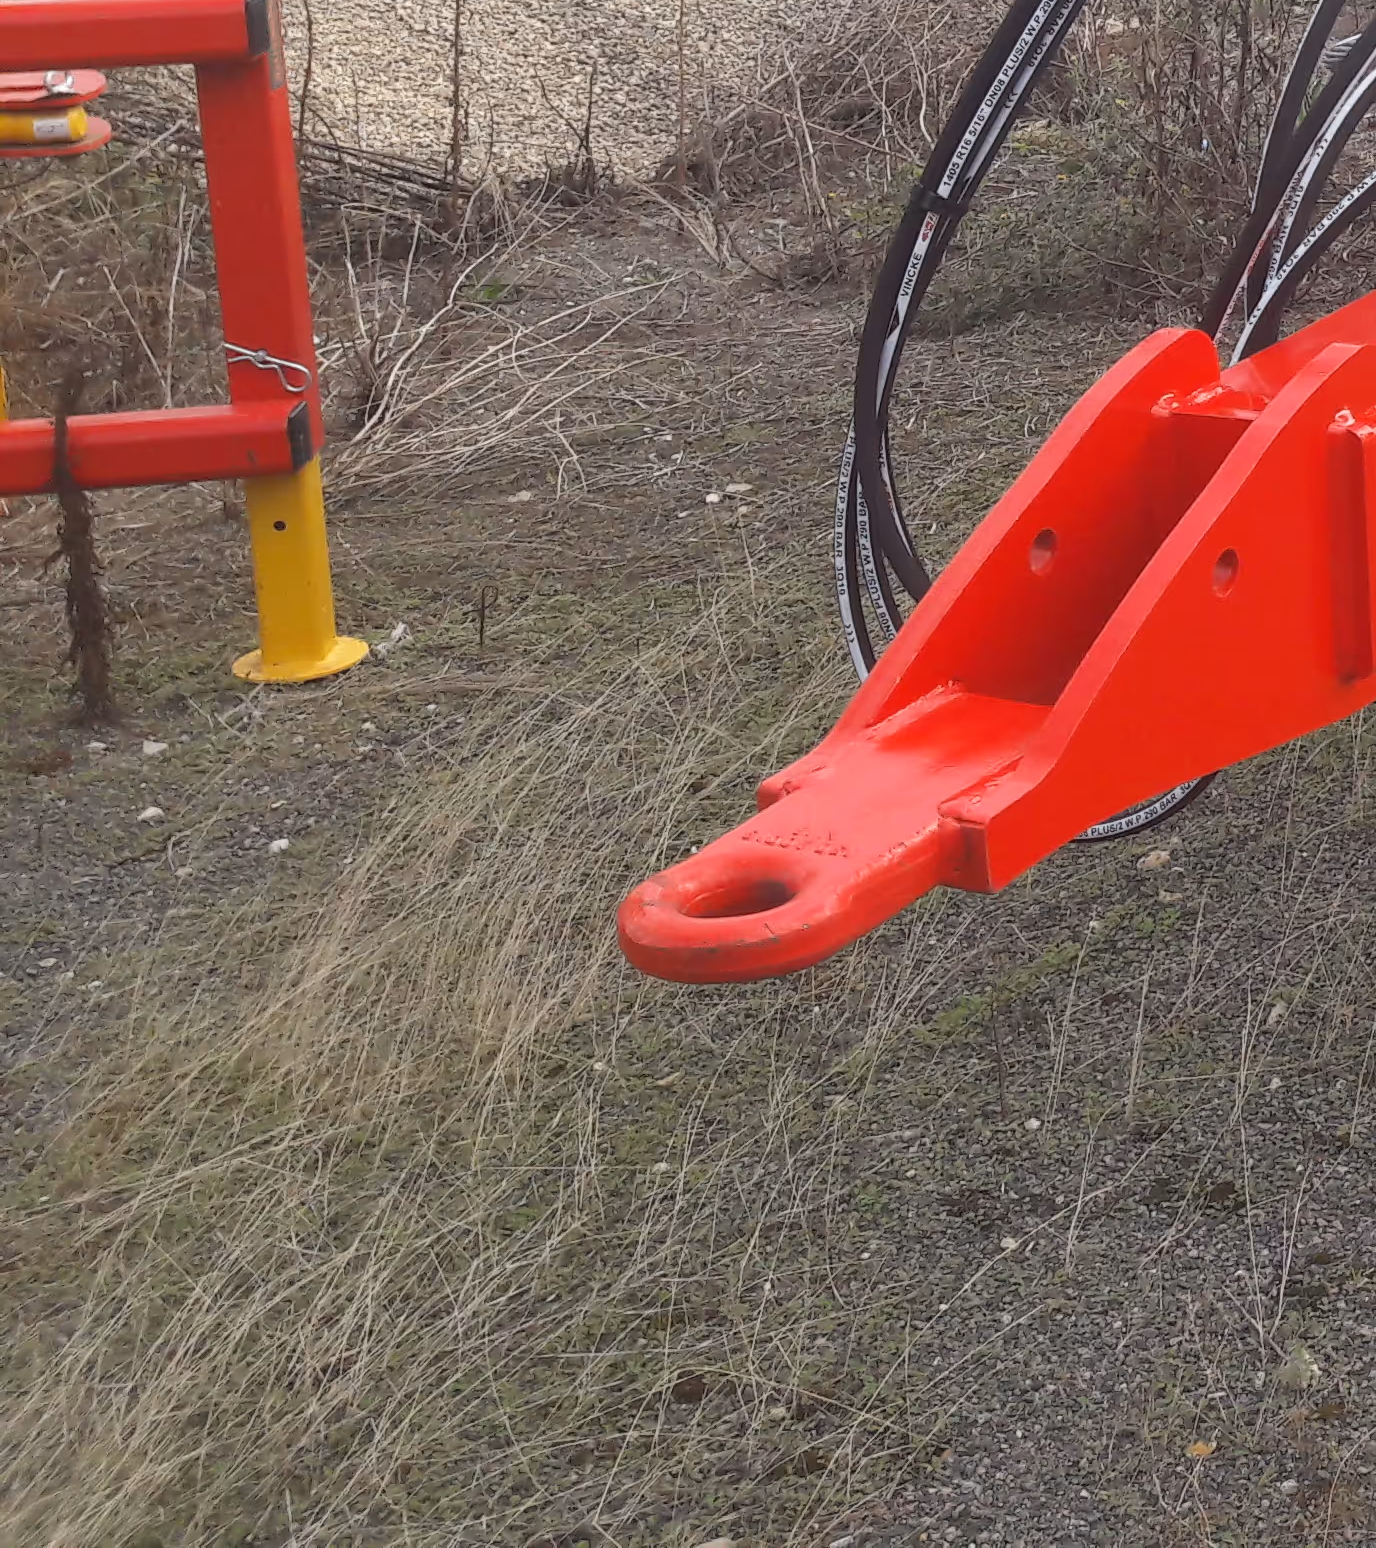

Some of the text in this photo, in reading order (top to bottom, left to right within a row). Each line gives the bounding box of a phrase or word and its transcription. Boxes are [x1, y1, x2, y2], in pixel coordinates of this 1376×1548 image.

[899, 252, 923, 297] VINCKE
[943, 161, 961, 187] 1405
[956, 138, 972, 161] R16
[984, 78, 1006, 108] DN08
[1002, 37, 1030, 79] PLUS/2
[835, 531, 844, 558] BAR
[865, 567, 884, 610] PLUS/2
[1090, 820, 1124, 838] PLUS/2
[1159, 792, 1178, 812] BAR
